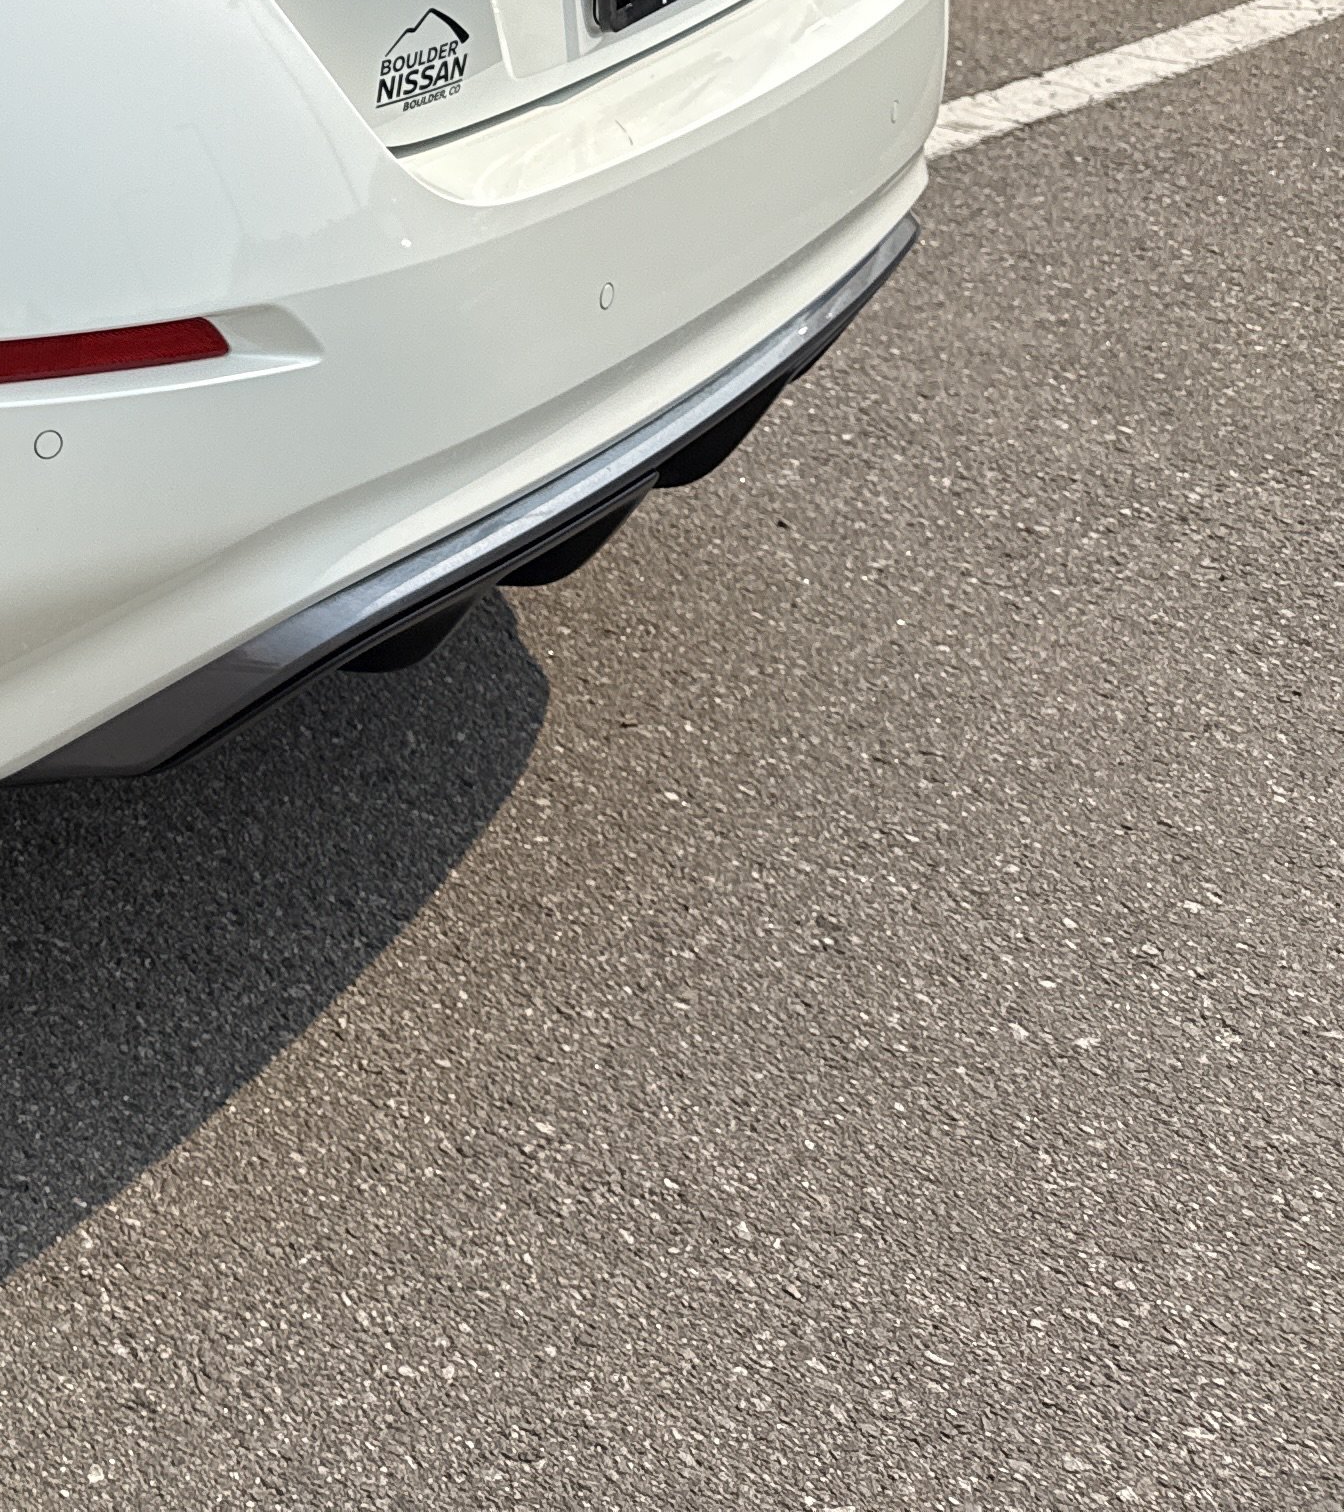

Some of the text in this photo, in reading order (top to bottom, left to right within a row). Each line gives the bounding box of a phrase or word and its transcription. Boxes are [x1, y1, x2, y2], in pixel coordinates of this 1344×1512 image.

[379, 40, 459, 77] BOULDER
[376, 53, 468, 103] NISSAN
[448, 84, 461, 96] CO
